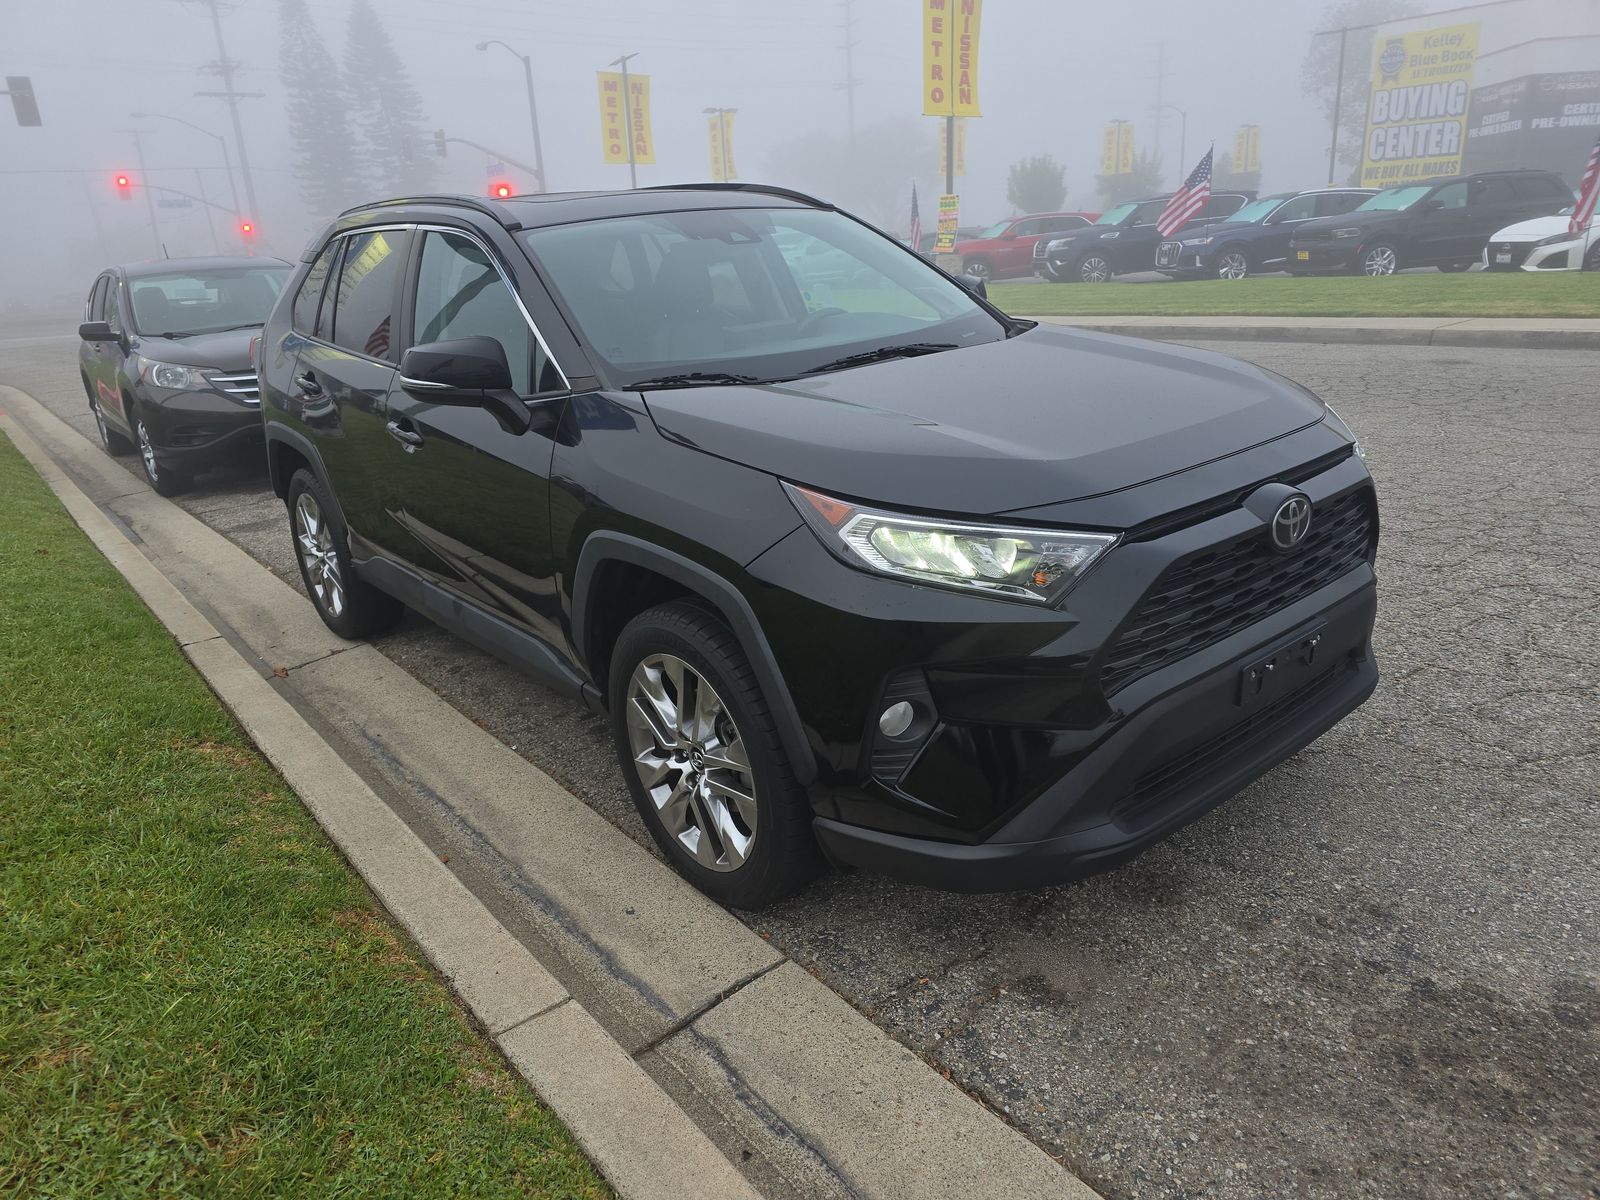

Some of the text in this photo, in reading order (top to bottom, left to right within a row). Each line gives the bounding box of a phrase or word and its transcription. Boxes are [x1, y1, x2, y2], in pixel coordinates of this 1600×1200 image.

[929, 0, 946, 104] METRO
[958, 0, 975, 105] NISSAN
[1409, 53, 1438, 68] Blue
[1440, 48, 1474, 64] Book
[1423, 32, 1465, 49] Kelley
[603, 80, 622, 155] METRO
[631, 82, 649, 156] NISSAN
[1371, 79, 1468, 125] BUYING
[1368, 120, 1463, 162] CENTER
[1364, 160, 1458, 180] WE BUY ALL MAKES
